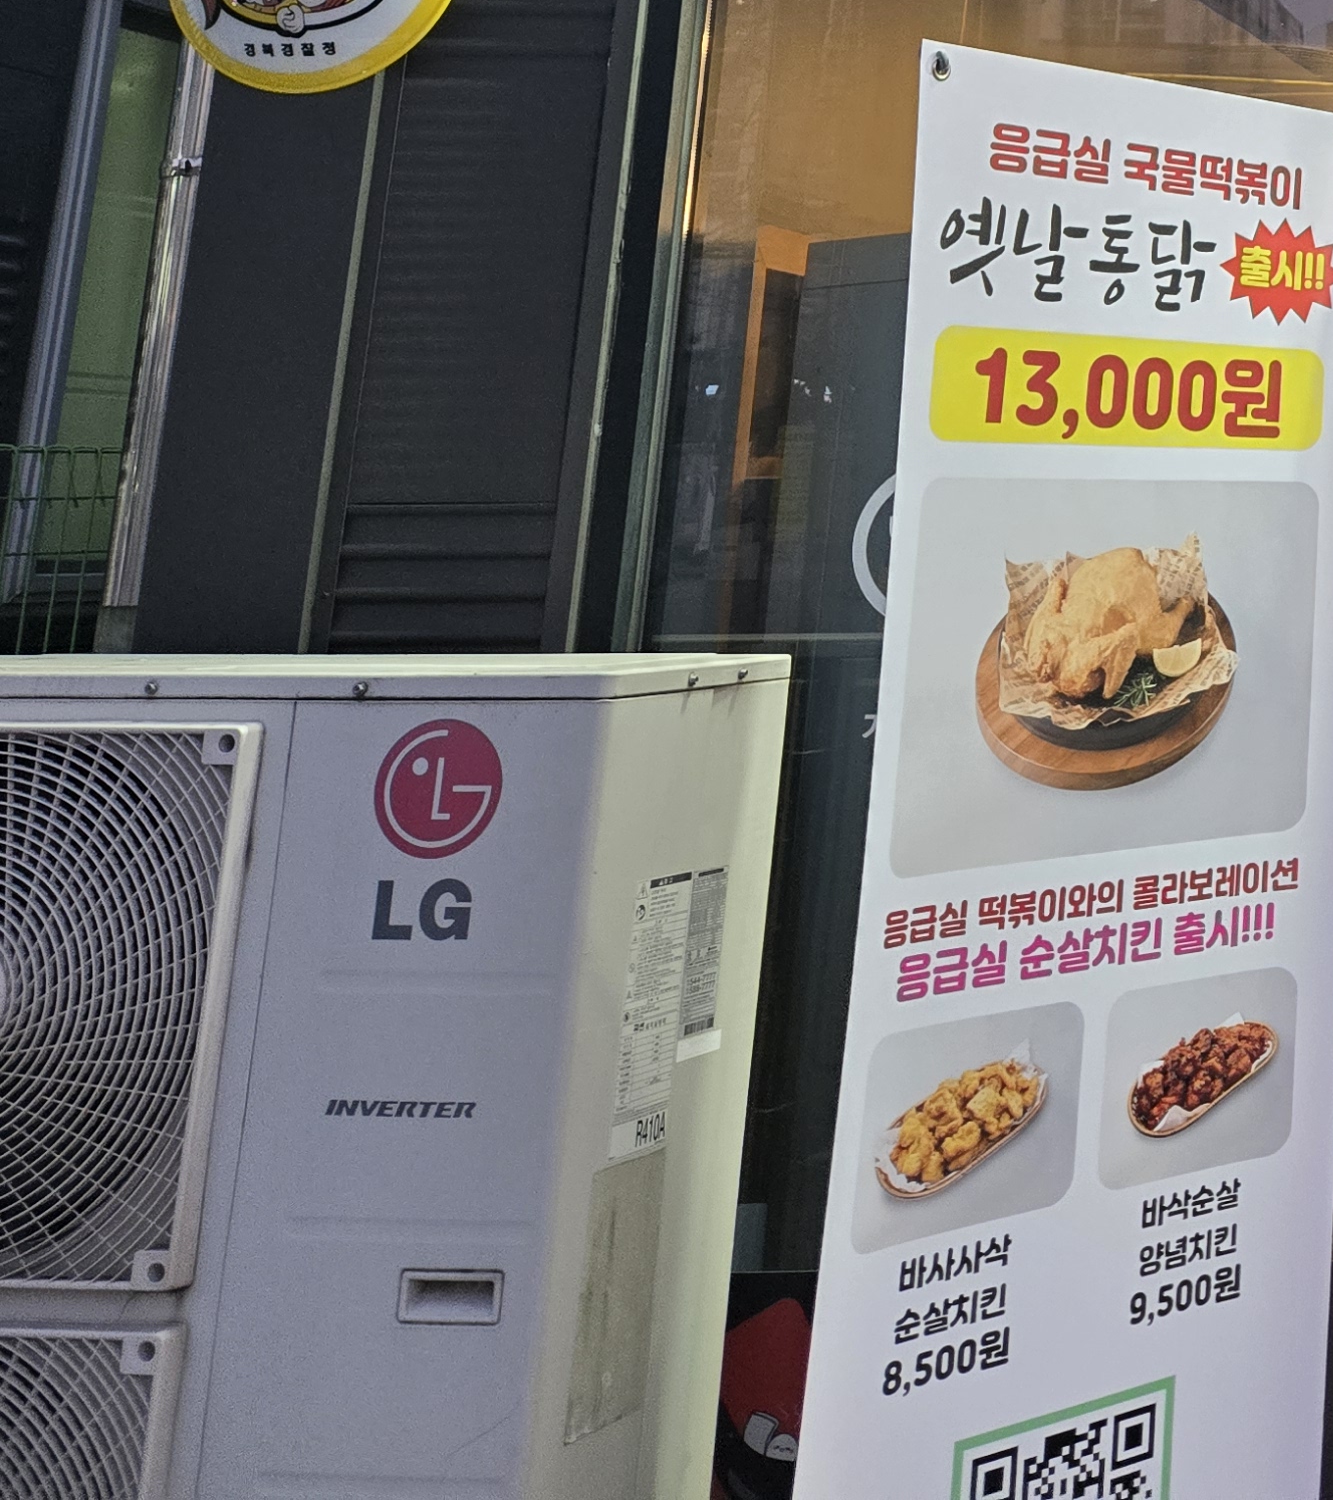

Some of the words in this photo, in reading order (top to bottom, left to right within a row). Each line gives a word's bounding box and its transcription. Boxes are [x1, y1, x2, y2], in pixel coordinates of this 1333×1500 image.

[989, 122, 1112, 186] 응급실
[1123, 142, 1303, 211] 국물떡볶이
[1240, 245, 1325, 291] 출시!!
[974, 347, 1283, 439] 13,000원
[371, 878, 473, 940] LG
[883, 899, 967, 949] 응급실
[977, 878, 1124, 930] 떡볶이와의
[1132, 857, 1300, 905] 콜라보레이션
[895, 940, 1008, 1003] 응급실
[1019, 918, 1162, 981] 순살치킨
[1173, 902, 1276, 955] 출시!!!
[325, 1099, 477, 1119] INVERTER
[635, 1111, 666, 1147] R410A
[1141, 1178, 1243, 1229] 바삭순살
[898, 1233, 1012, 1293] 바사사삭
[1138, 1223, 1238, 1277] 양념치킨
[894, 1283, 1008, 1345] 순살치킨
[1129, 1264, 1243, 1328] 9,500원
[881, 1327, 1011, 1398] 8,500원
